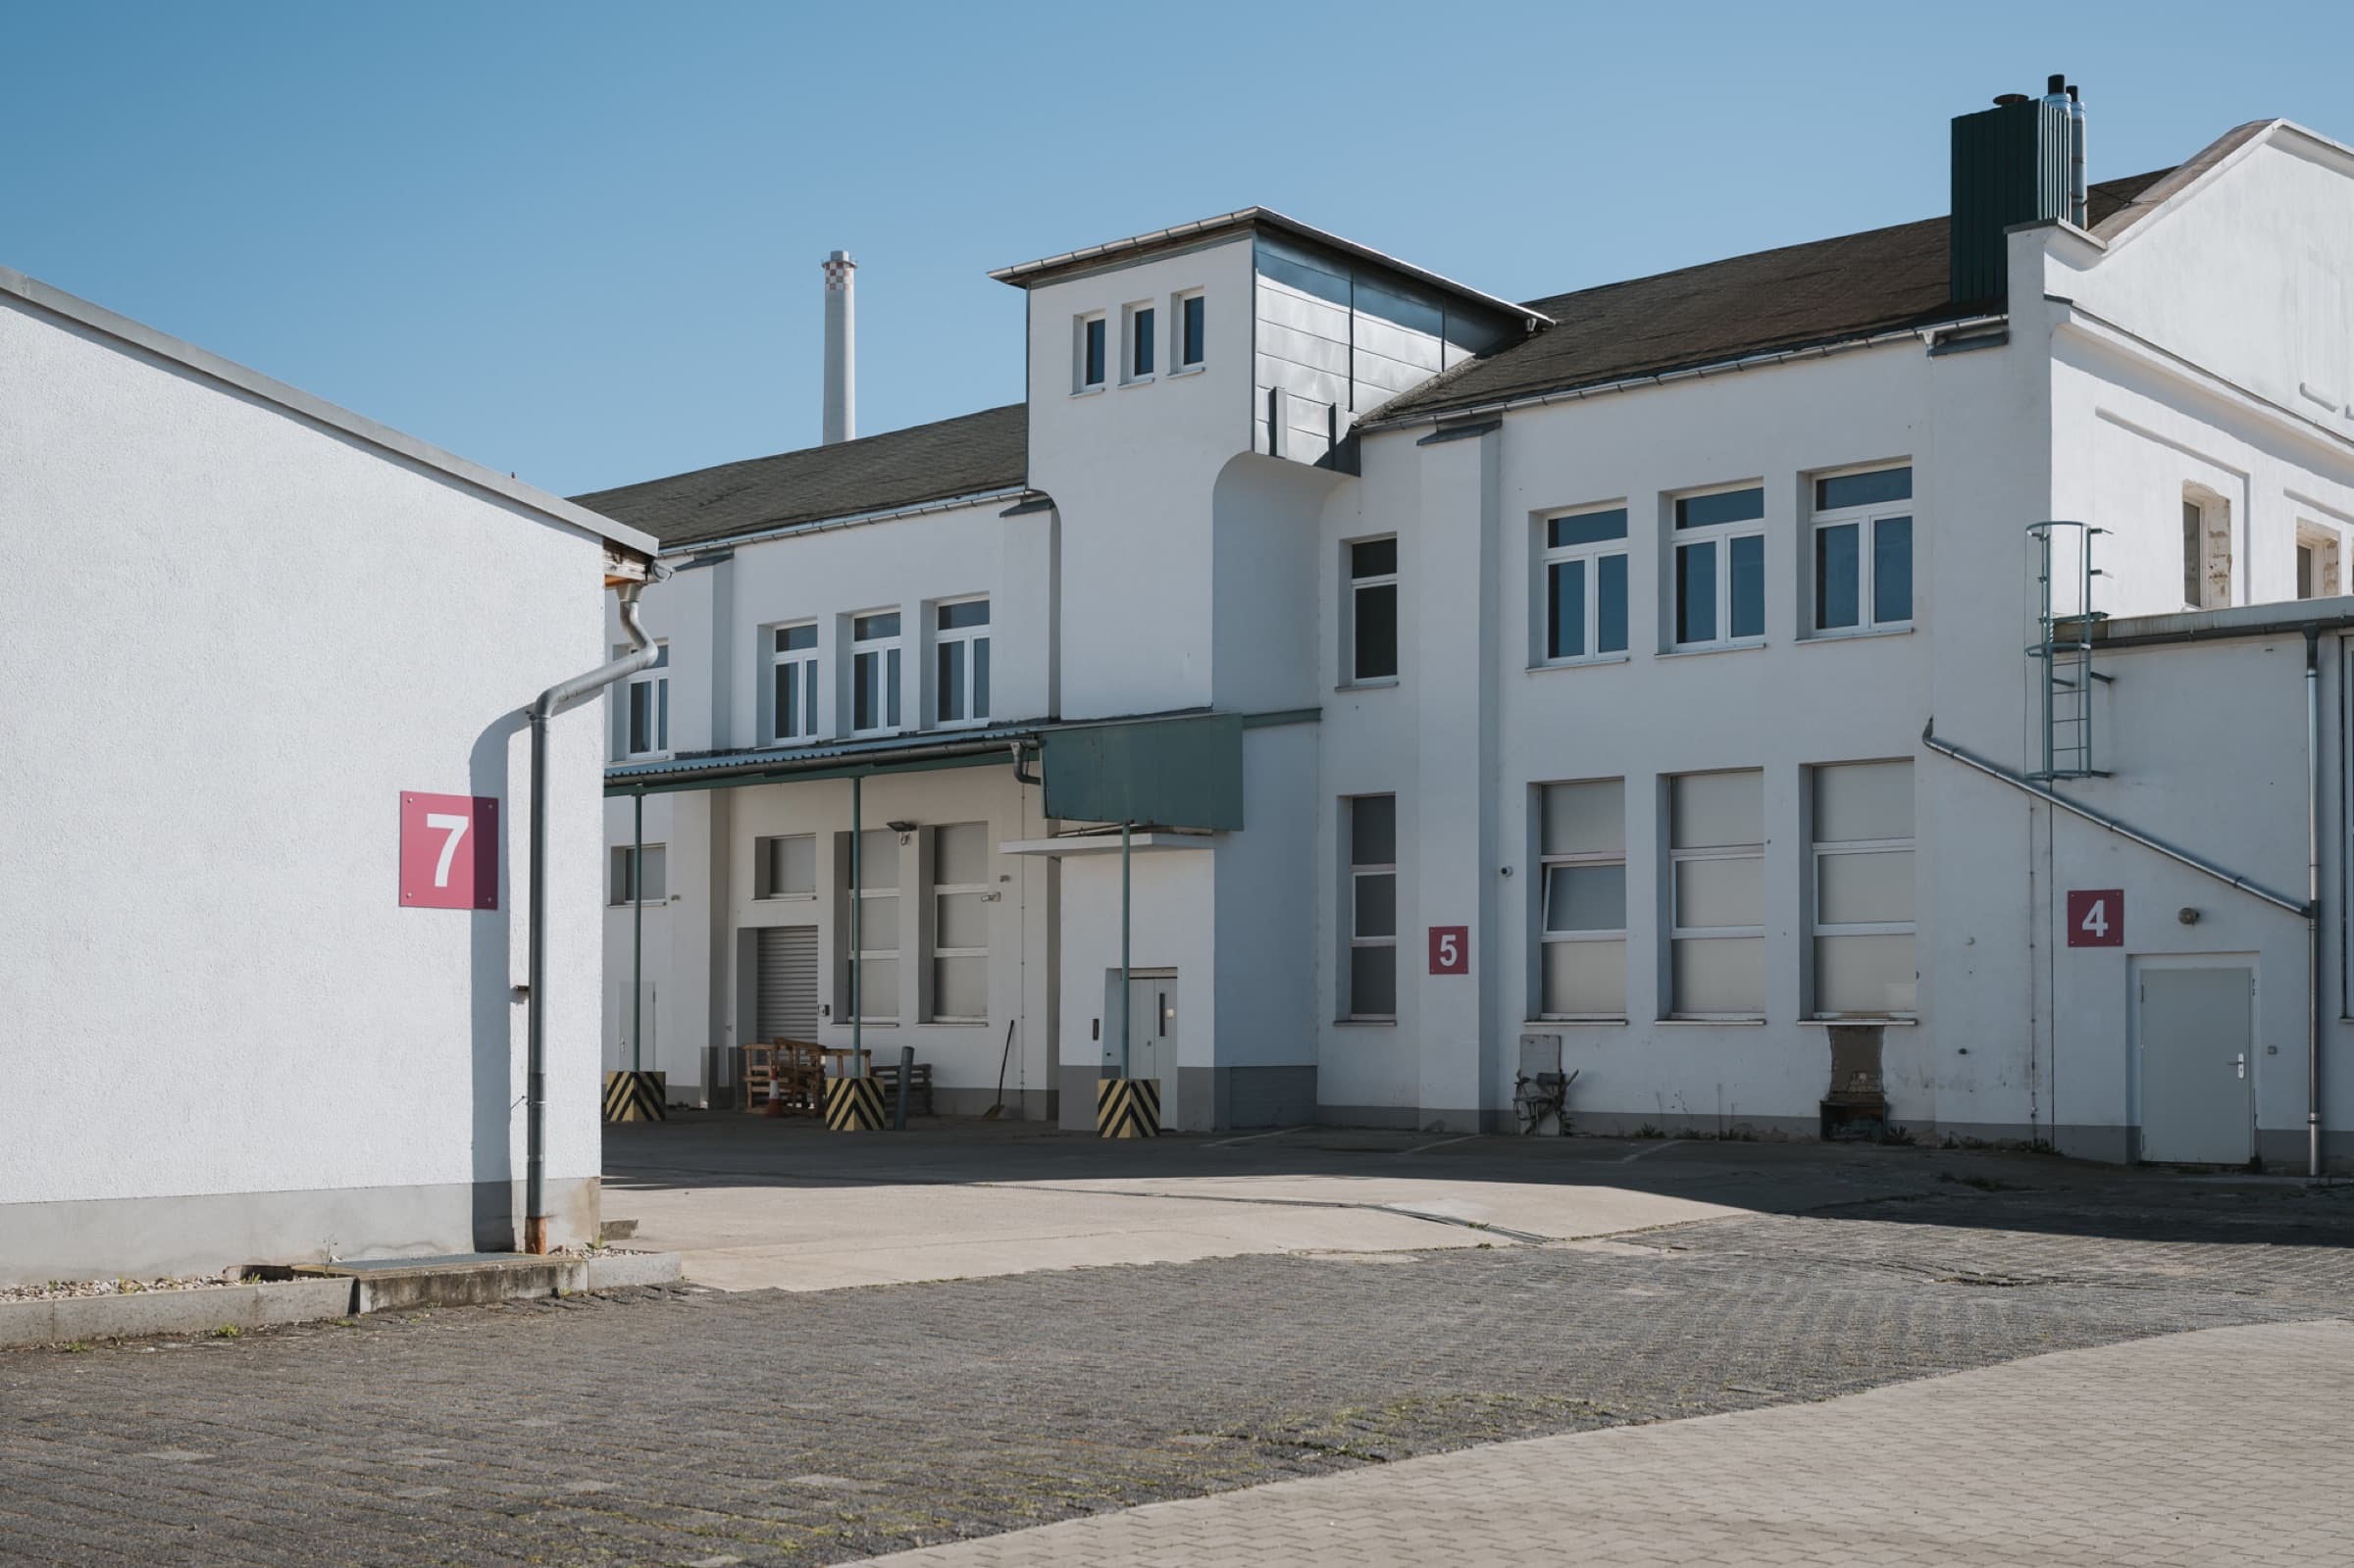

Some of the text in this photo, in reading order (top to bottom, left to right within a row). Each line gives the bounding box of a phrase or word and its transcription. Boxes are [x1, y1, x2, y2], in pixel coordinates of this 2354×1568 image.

[426, 812, 471, 888] 7
[2081, 899, 2109, 937] 4
[1439, 934, 1458, 967] 5
